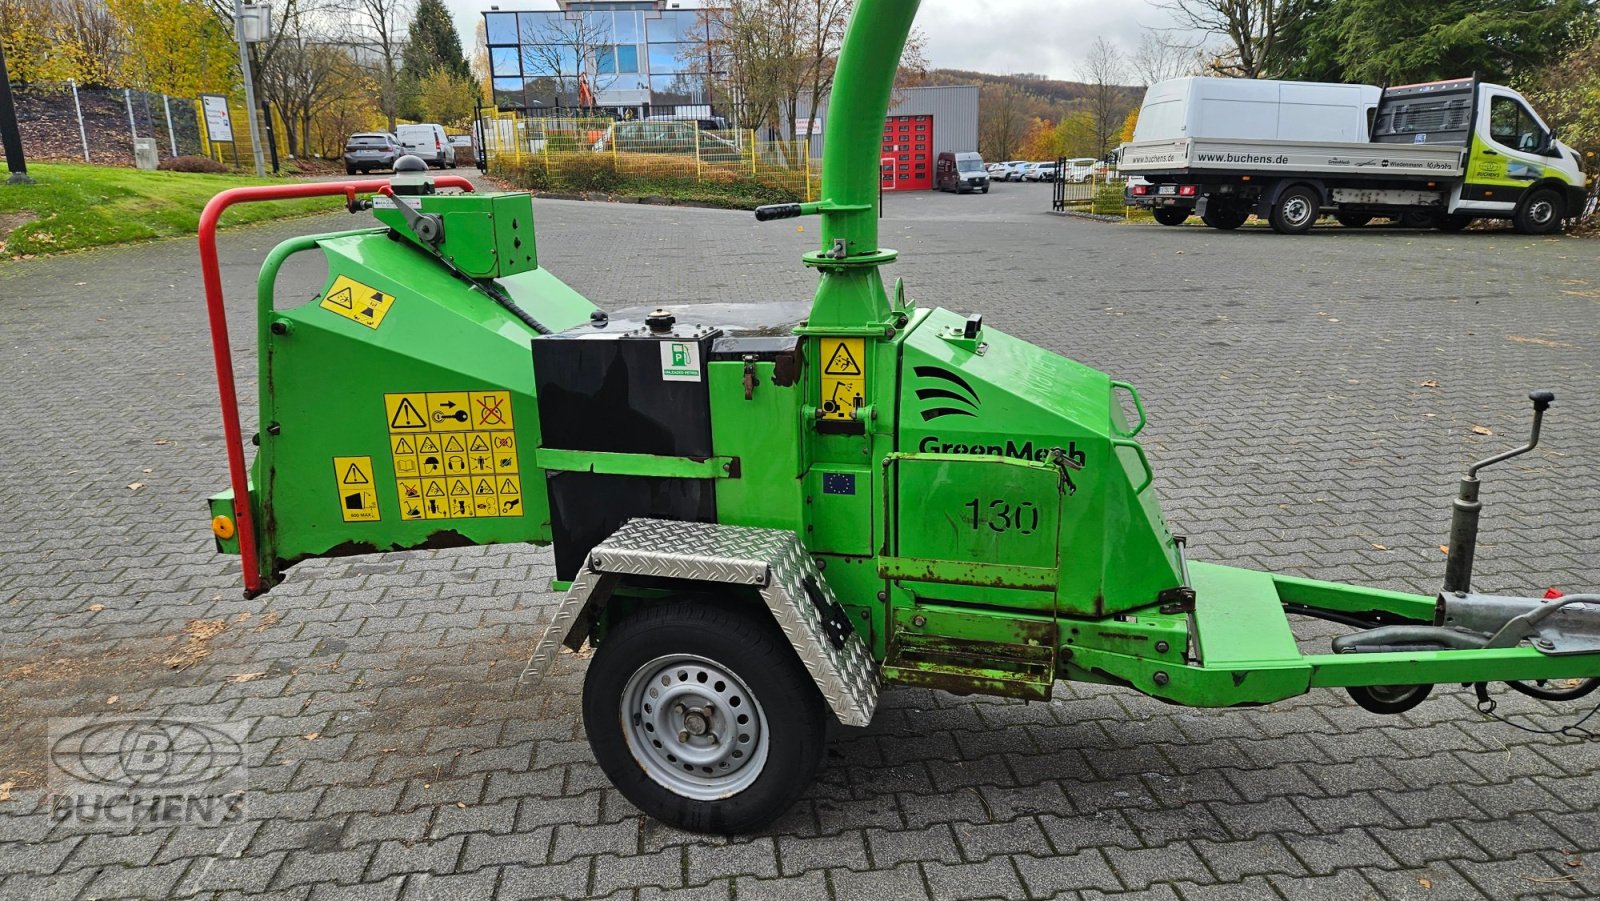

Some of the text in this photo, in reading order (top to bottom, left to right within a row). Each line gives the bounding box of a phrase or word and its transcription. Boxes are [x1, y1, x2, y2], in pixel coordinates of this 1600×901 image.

[1132, 154, 1174, 163] www.buchens.de
[1198, 153, 1289, 165] www.buchens.de
[1427, 162, 1452, 170] Kubota
[964, 498, 1038, 534] 130
